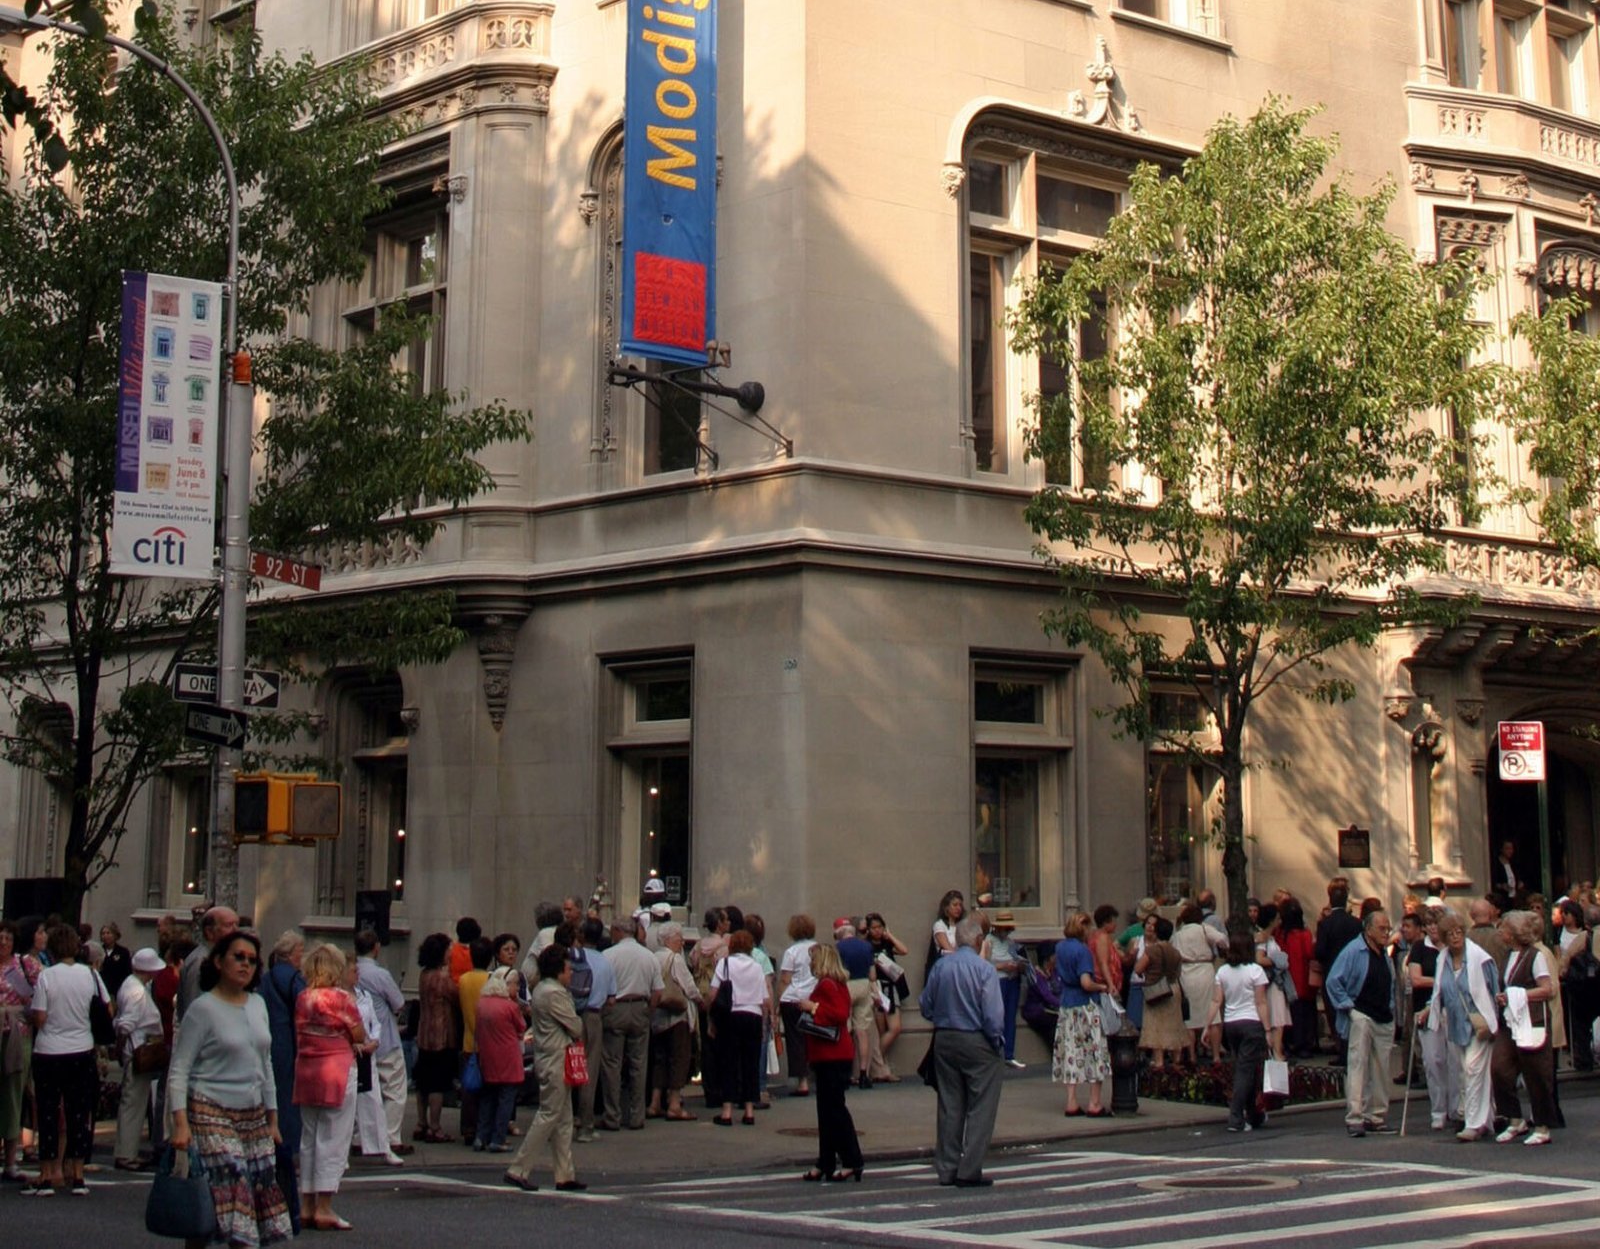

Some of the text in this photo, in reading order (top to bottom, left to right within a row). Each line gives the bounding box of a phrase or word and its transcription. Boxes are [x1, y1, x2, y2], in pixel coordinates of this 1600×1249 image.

[176, 467, 198, 479] June
[132, 533, 185, 566] citi
[250, 552, 308, 586] E 92 ST
[189, 676, 217, 693] ONE
[193, 714, 240, 736] ONE WAY
[1501, 725, 1539, 733] NO STANDING
[1506, 733, 1535, 741] ANYTIME
